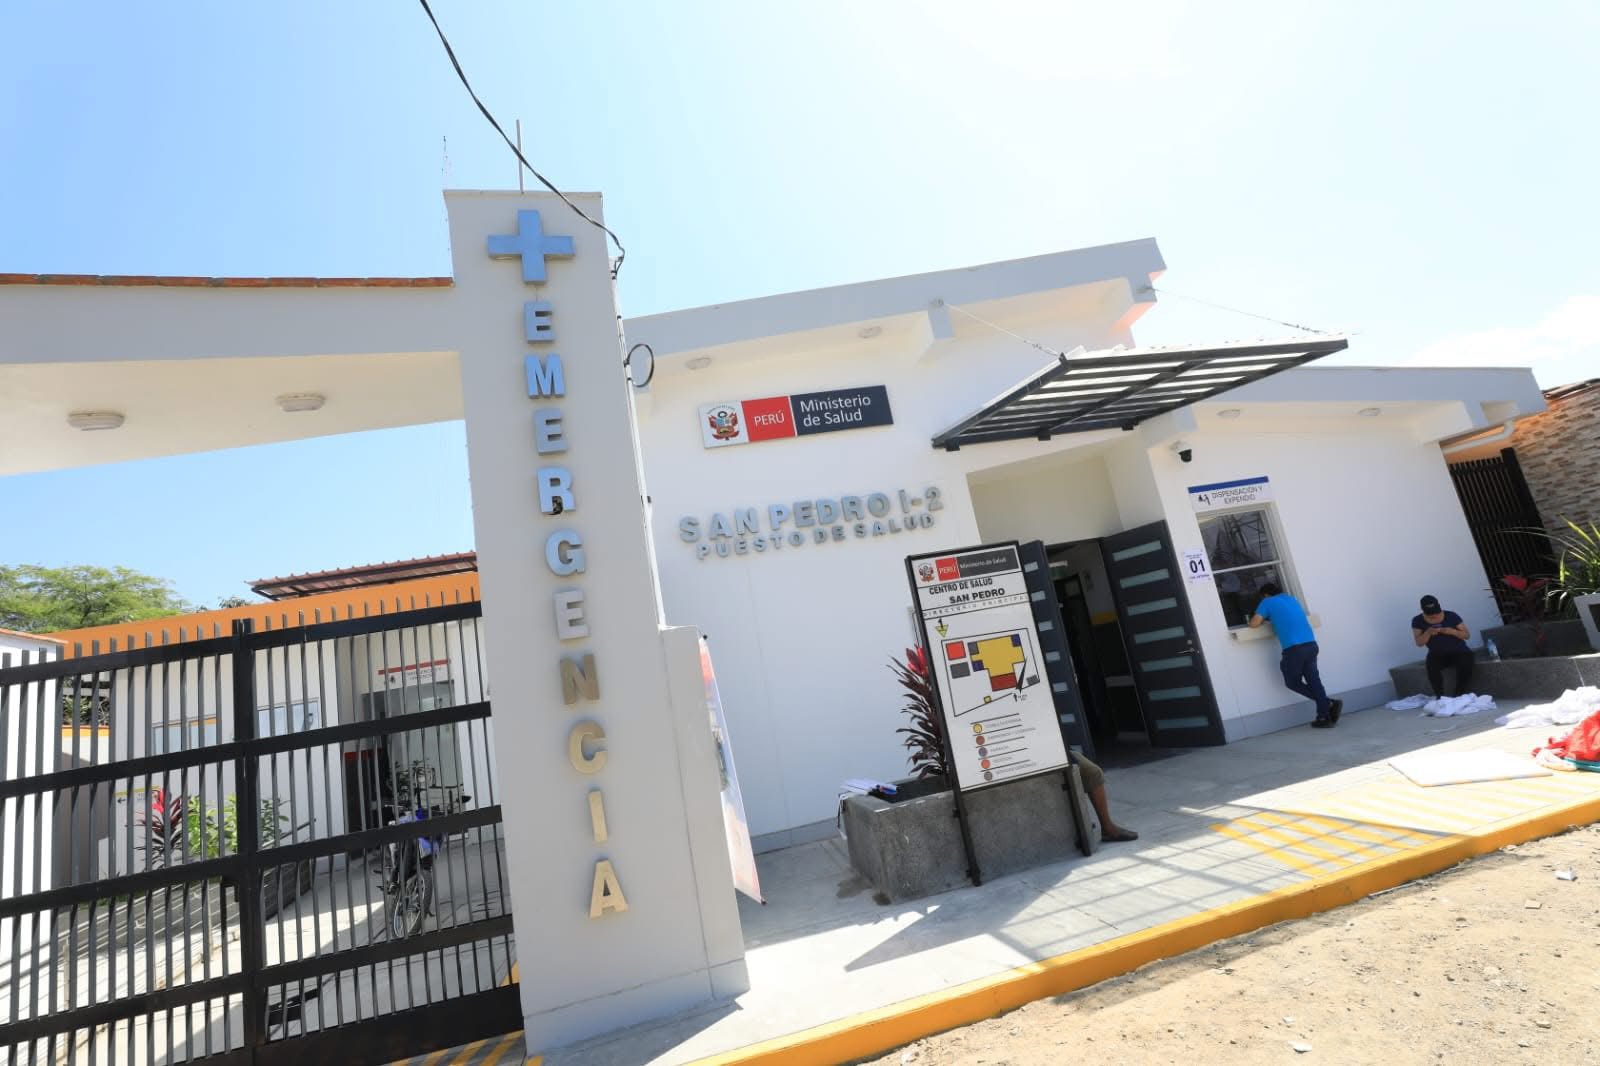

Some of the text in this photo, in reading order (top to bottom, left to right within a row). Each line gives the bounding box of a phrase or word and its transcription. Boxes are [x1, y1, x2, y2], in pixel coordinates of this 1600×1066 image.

[800, 394, 872, 413] Ministerio
[753, 411, 785, 427] PERÚ
[803, 409, 863, 427] de Salud
[679, 486, 944, 543] SAN PEDRO I-2
[697, 512, 935, 560] PUESTO DE SALUD
[1189, 559, 1206, 573] 01
[929, 576, 993, 595] CENTRO DE SALUD
[949, 587, 1006, 604] SAN PEDRO
[523, 300, 629, 920] EMERGENCIA
